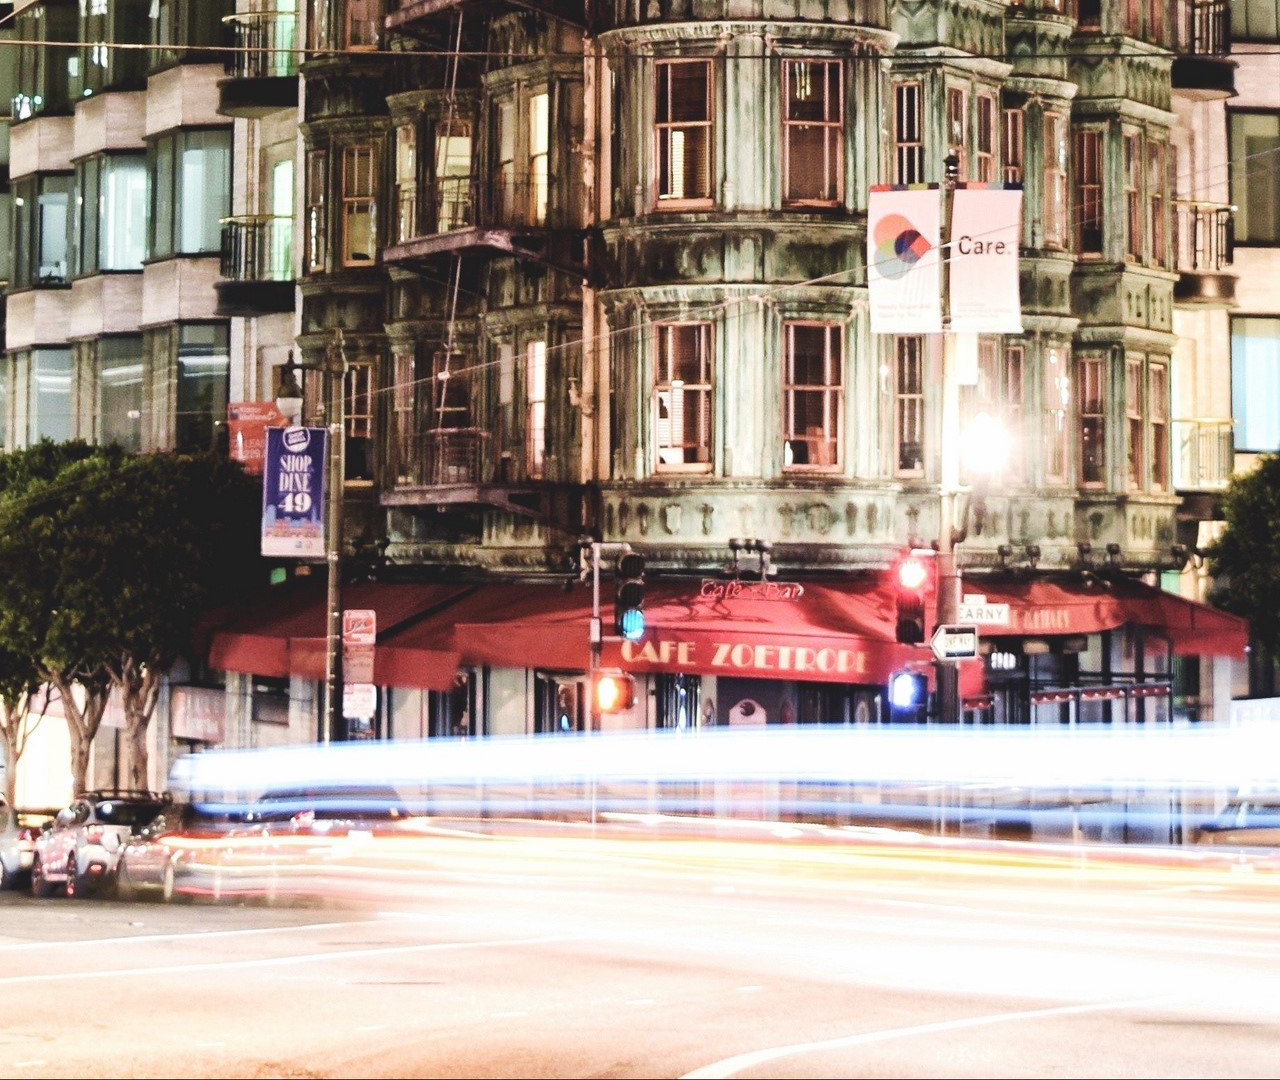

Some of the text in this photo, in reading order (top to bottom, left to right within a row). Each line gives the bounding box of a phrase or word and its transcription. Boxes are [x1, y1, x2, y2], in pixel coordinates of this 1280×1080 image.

[958, 235, 1012, 255] Care.
[279, 455, 313, 473] SHOP
[278, 473, 311, 492] DINE
[278, 493, 312, 513] 49
[620, 640, 871, 674] CAFE ZOETROPE
